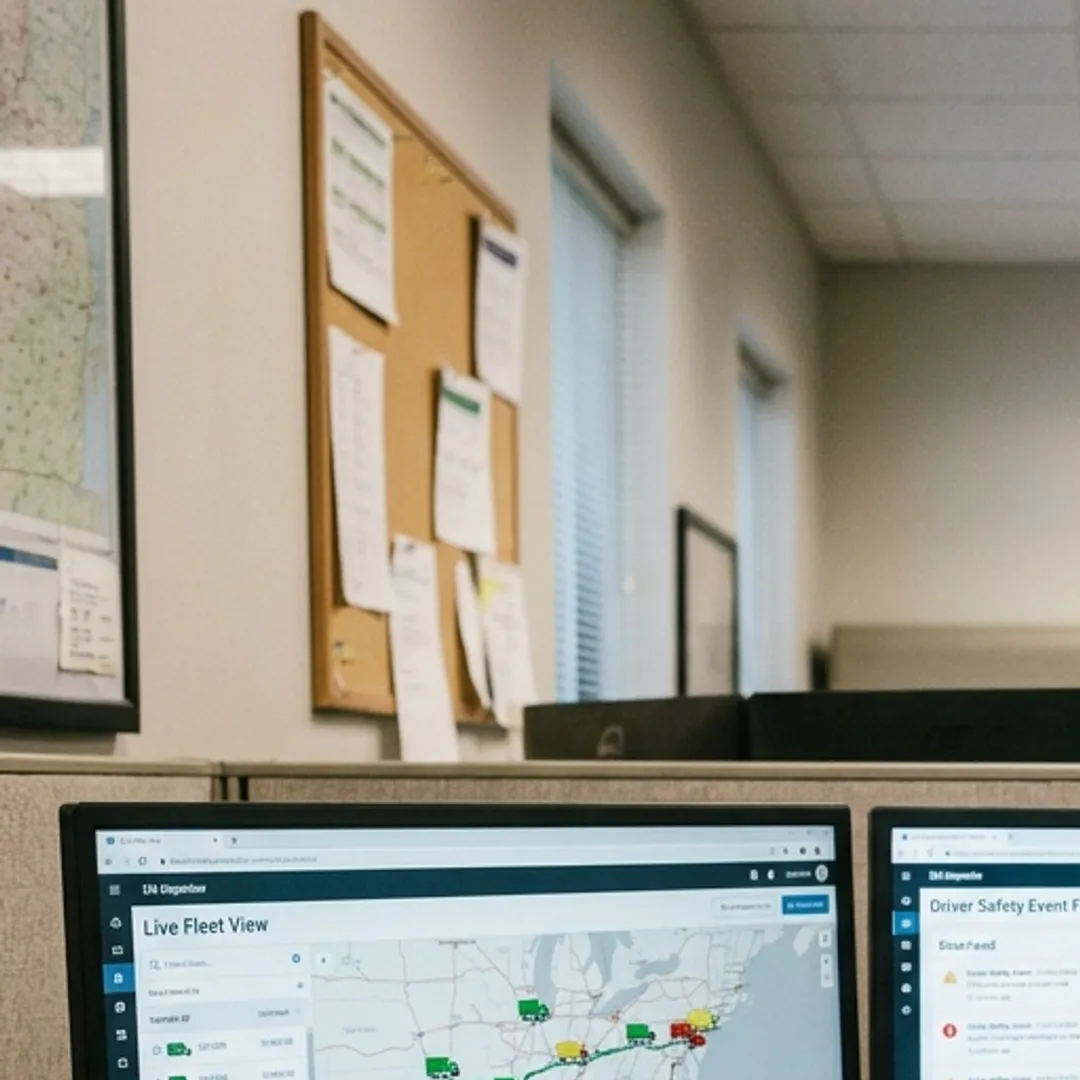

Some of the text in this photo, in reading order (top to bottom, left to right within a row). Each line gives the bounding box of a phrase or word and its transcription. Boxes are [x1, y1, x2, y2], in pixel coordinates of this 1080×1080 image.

[978, 897, 1025, 916] Safety
[1028, 898, 1068, 913] Event
[143, 915, 269, 936] Live Fleet View
